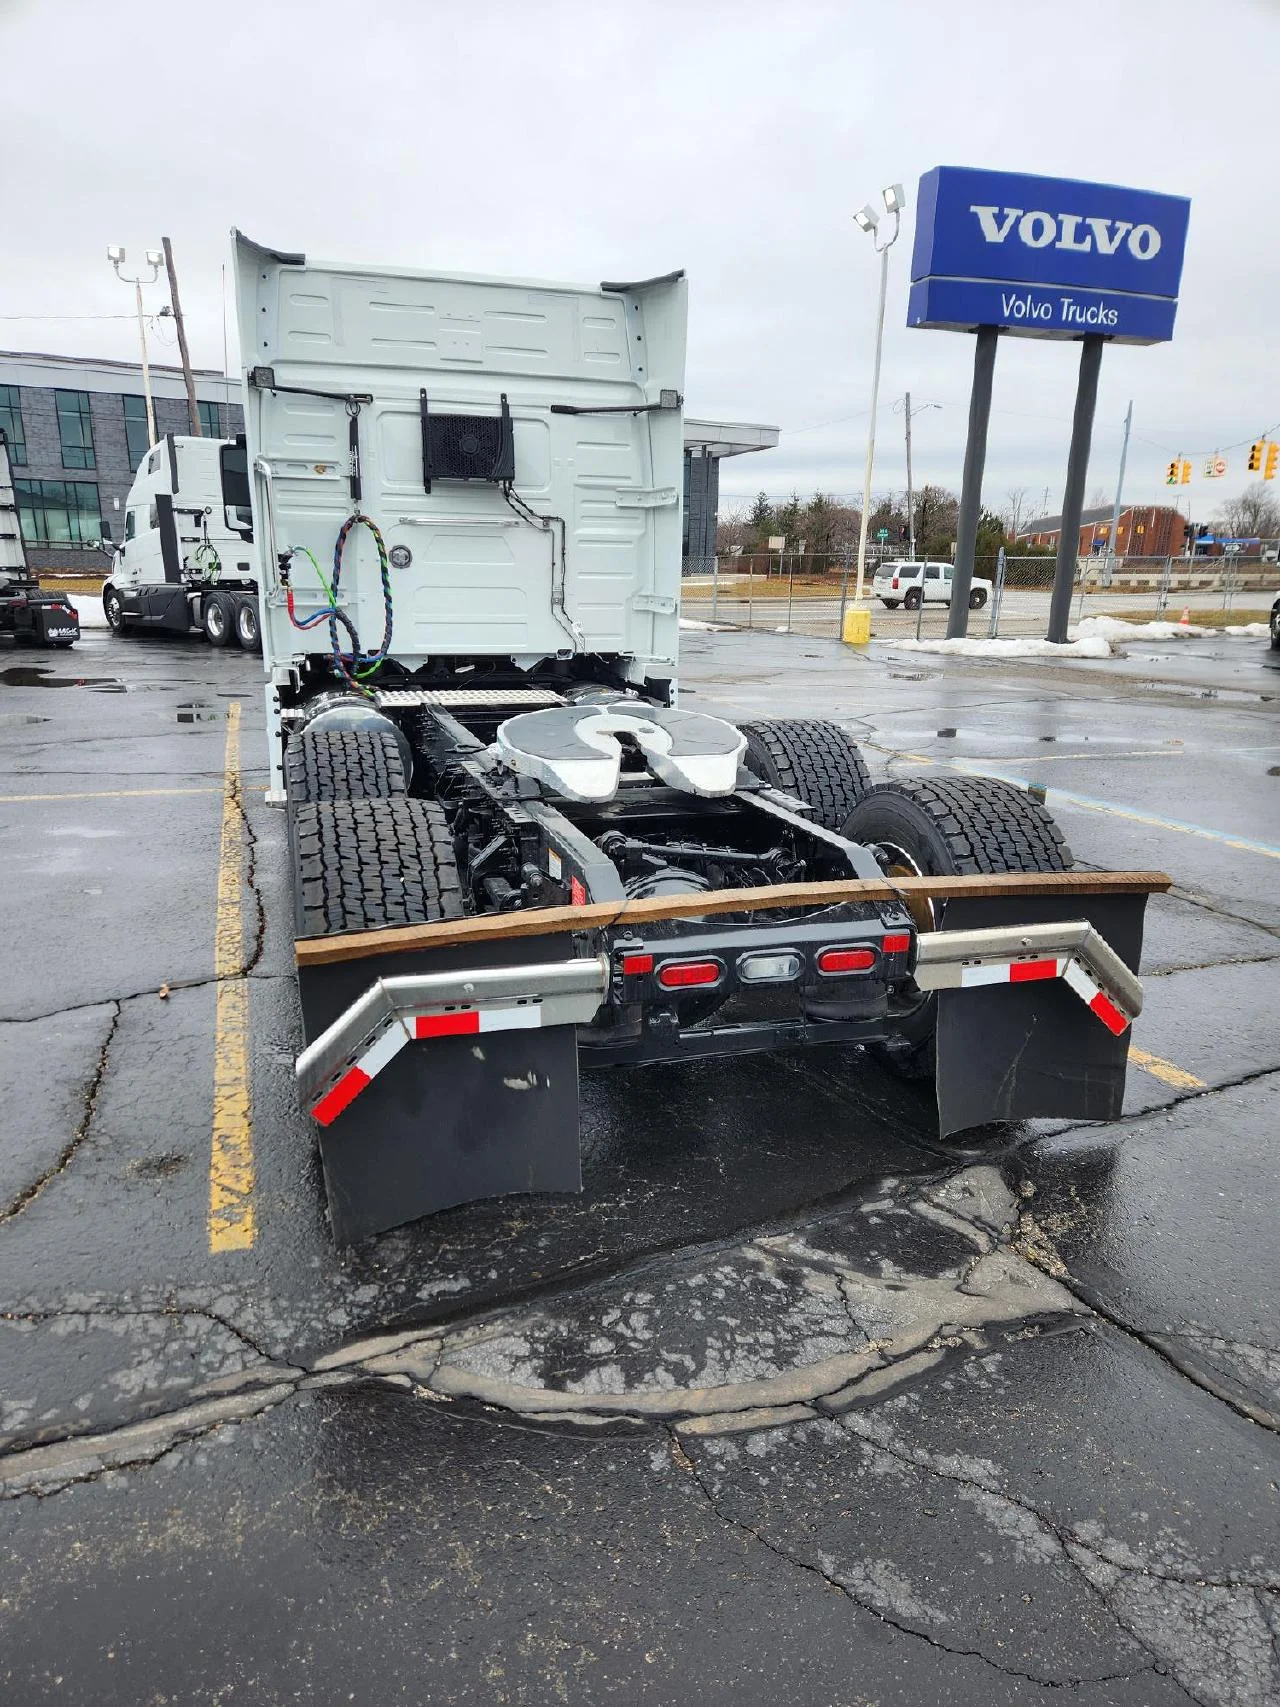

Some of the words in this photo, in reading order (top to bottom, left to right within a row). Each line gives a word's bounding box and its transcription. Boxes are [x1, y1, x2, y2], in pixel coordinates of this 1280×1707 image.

[969, 205, 1162, 260] VOLVO
[1001, 293, 1053, 321] Volvo
[1060, 297, 1119, 326] Trucks
